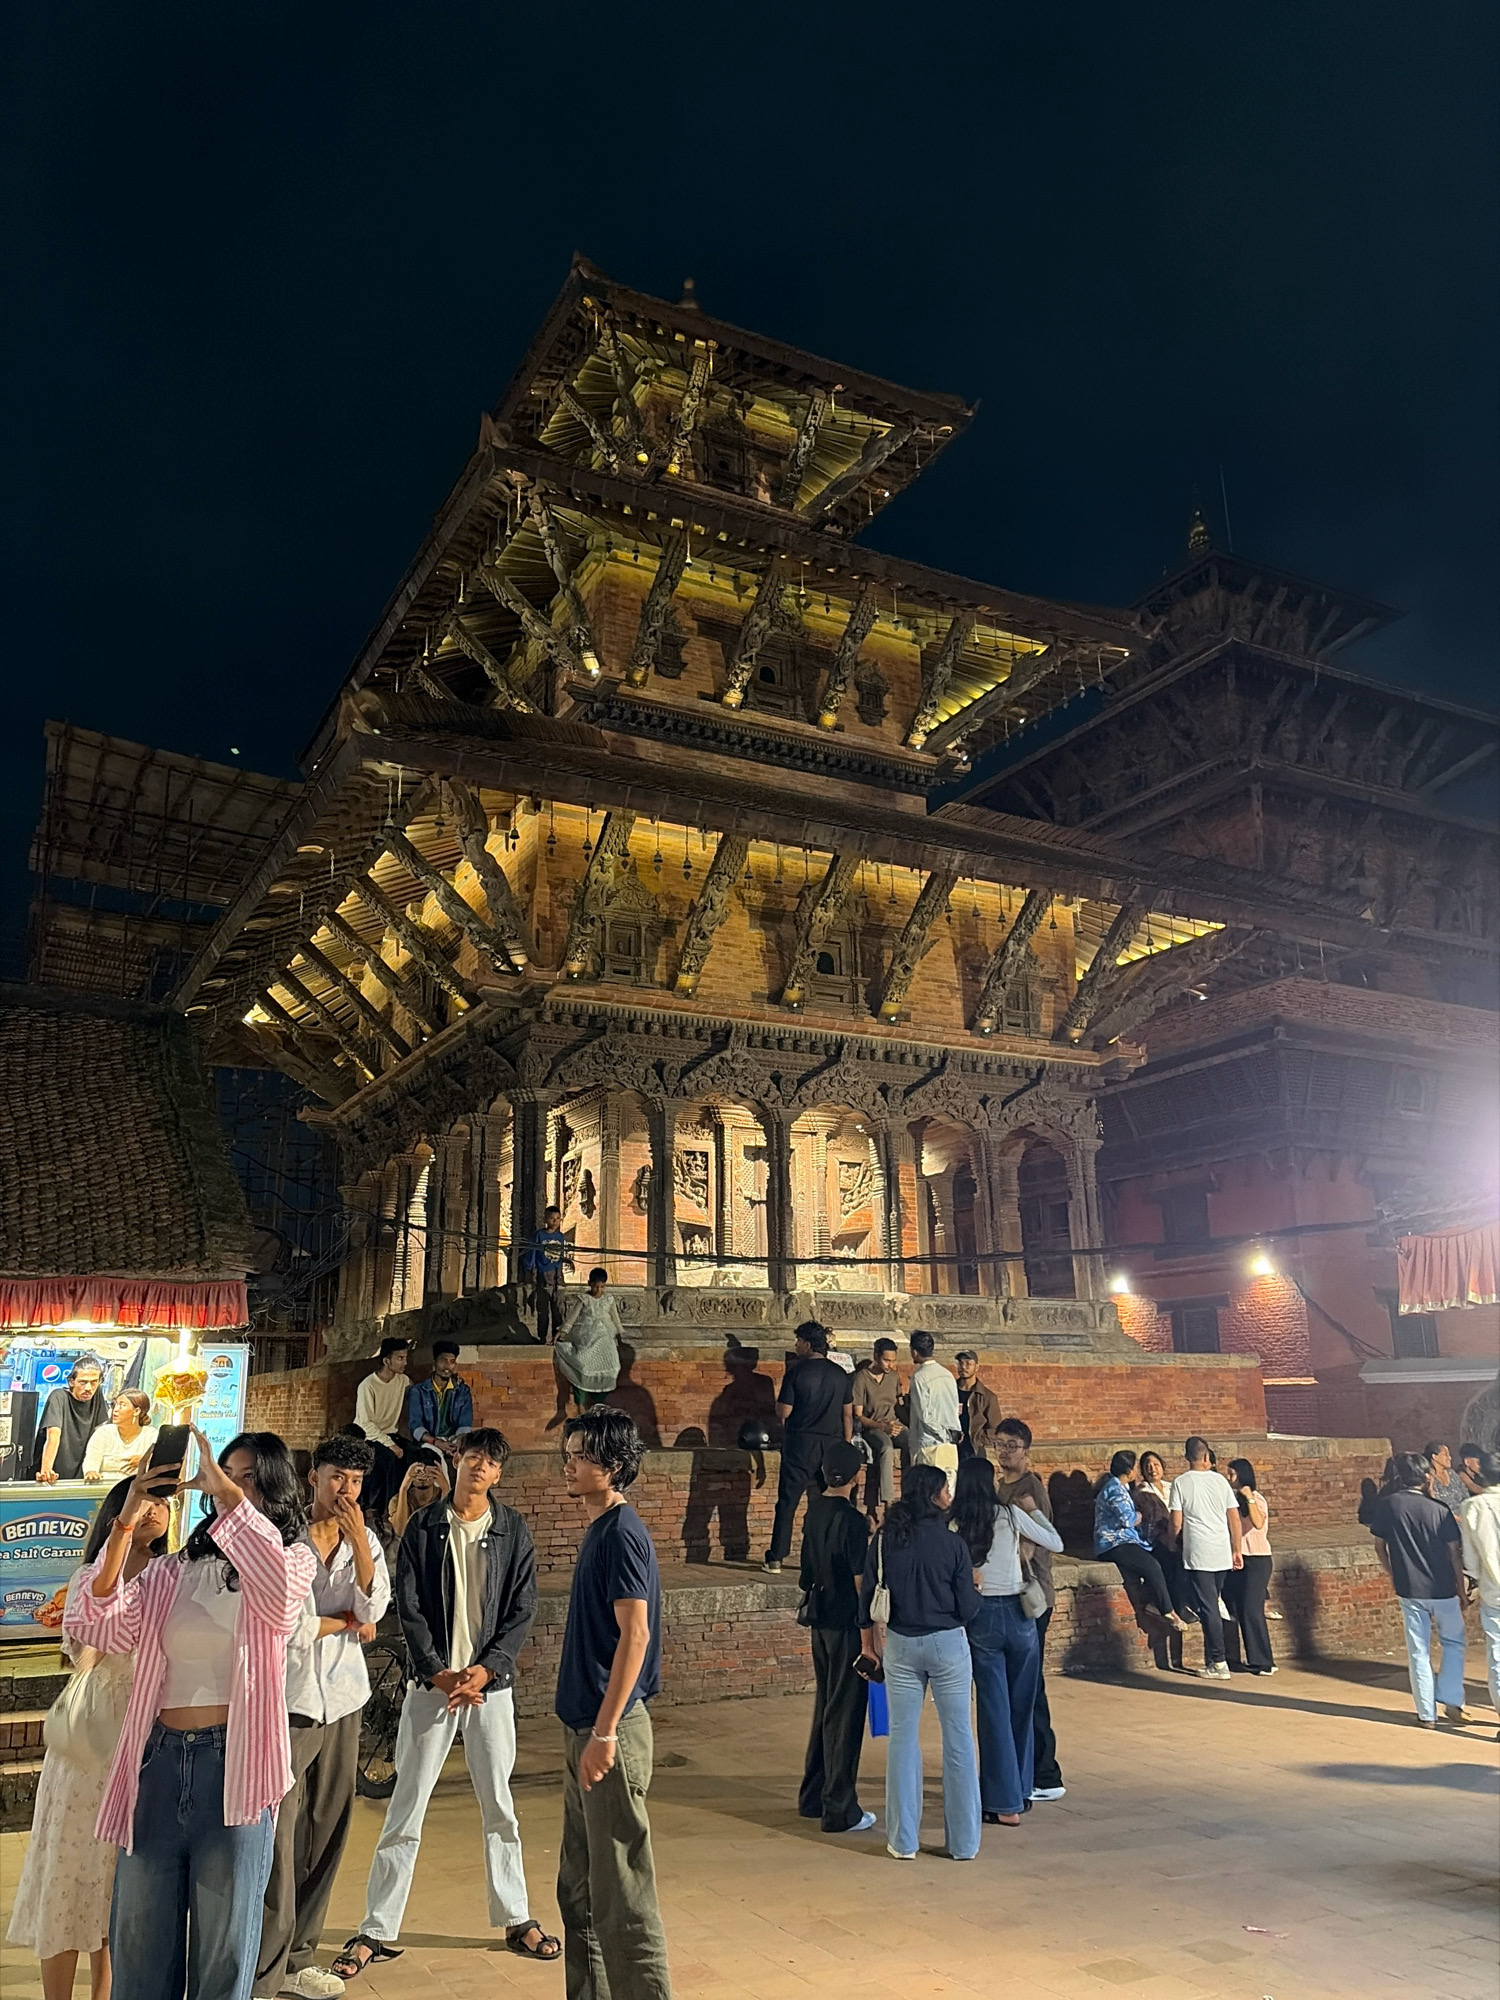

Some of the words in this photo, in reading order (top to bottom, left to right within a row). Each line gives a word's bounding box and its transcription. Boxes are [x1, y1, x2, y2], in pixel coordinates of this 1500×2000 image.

[5, 1521, 36, 1540] BEN
[38, 1520, 86, 1538] NEVIS
[0, 1552, 10, 1560] ea
[14, 1548, 38, 1559] Salt
[41, 1547, 84, 1558] Caram
